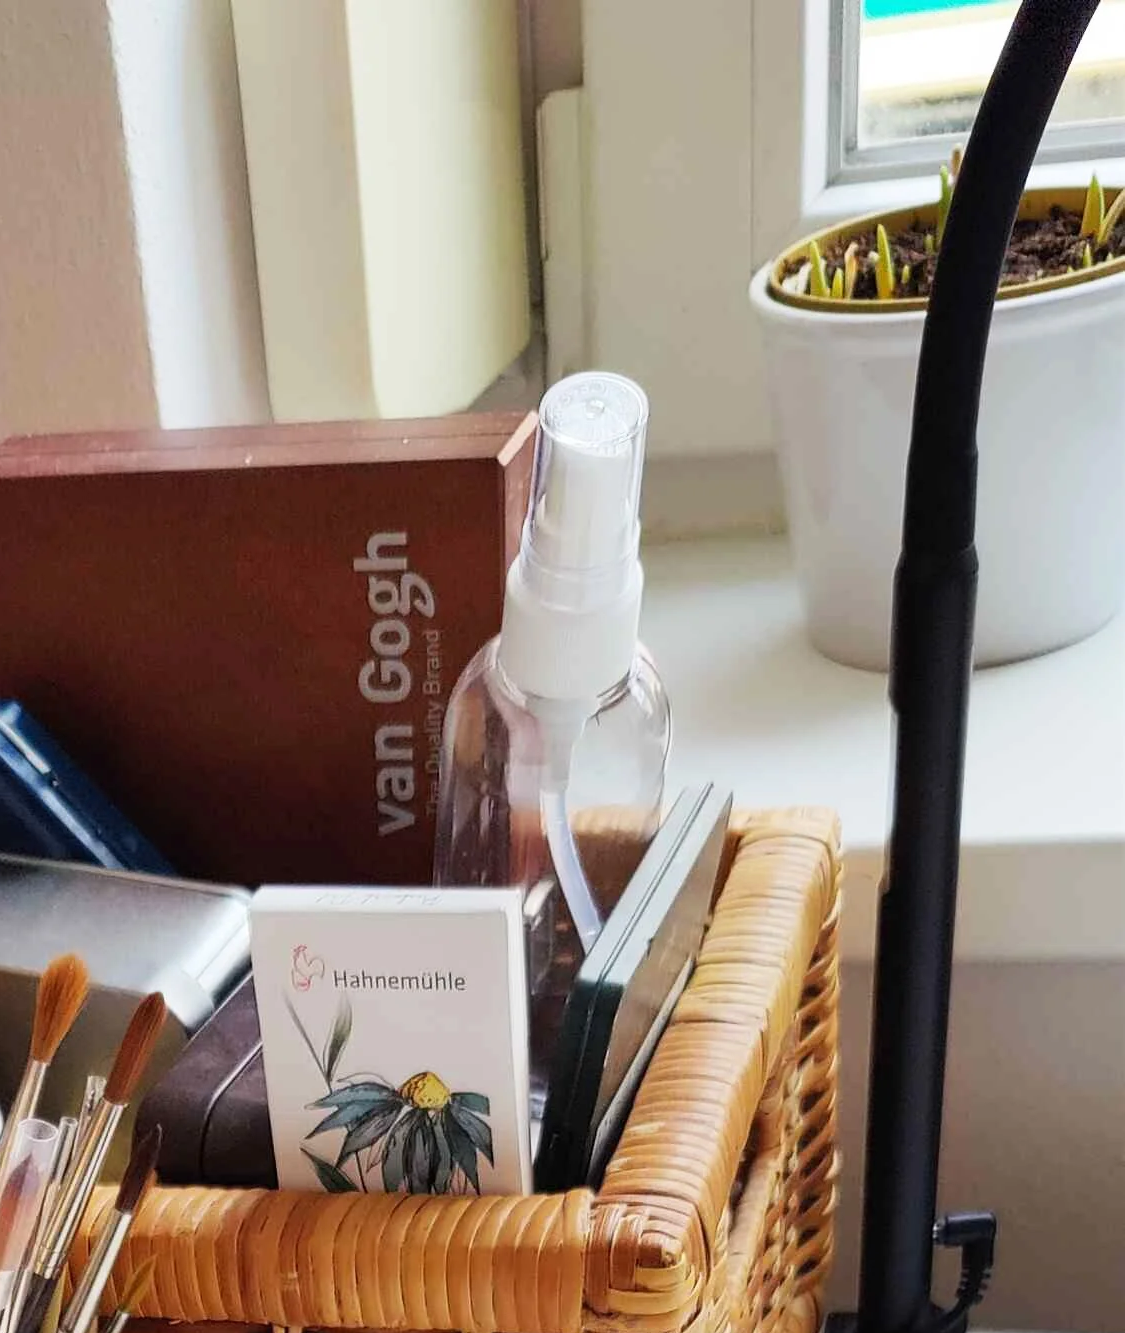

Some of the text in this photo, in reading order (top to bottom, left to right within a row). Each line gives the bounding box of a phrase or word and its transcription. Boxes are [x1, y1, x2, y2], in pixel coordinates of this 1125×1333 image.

[353, 531, 435, 704] Gogh
[422, 629, 442, 696] Brand
[375, 724, 415, 837] van
[333, 970, 467, 992] Hahnemühle
